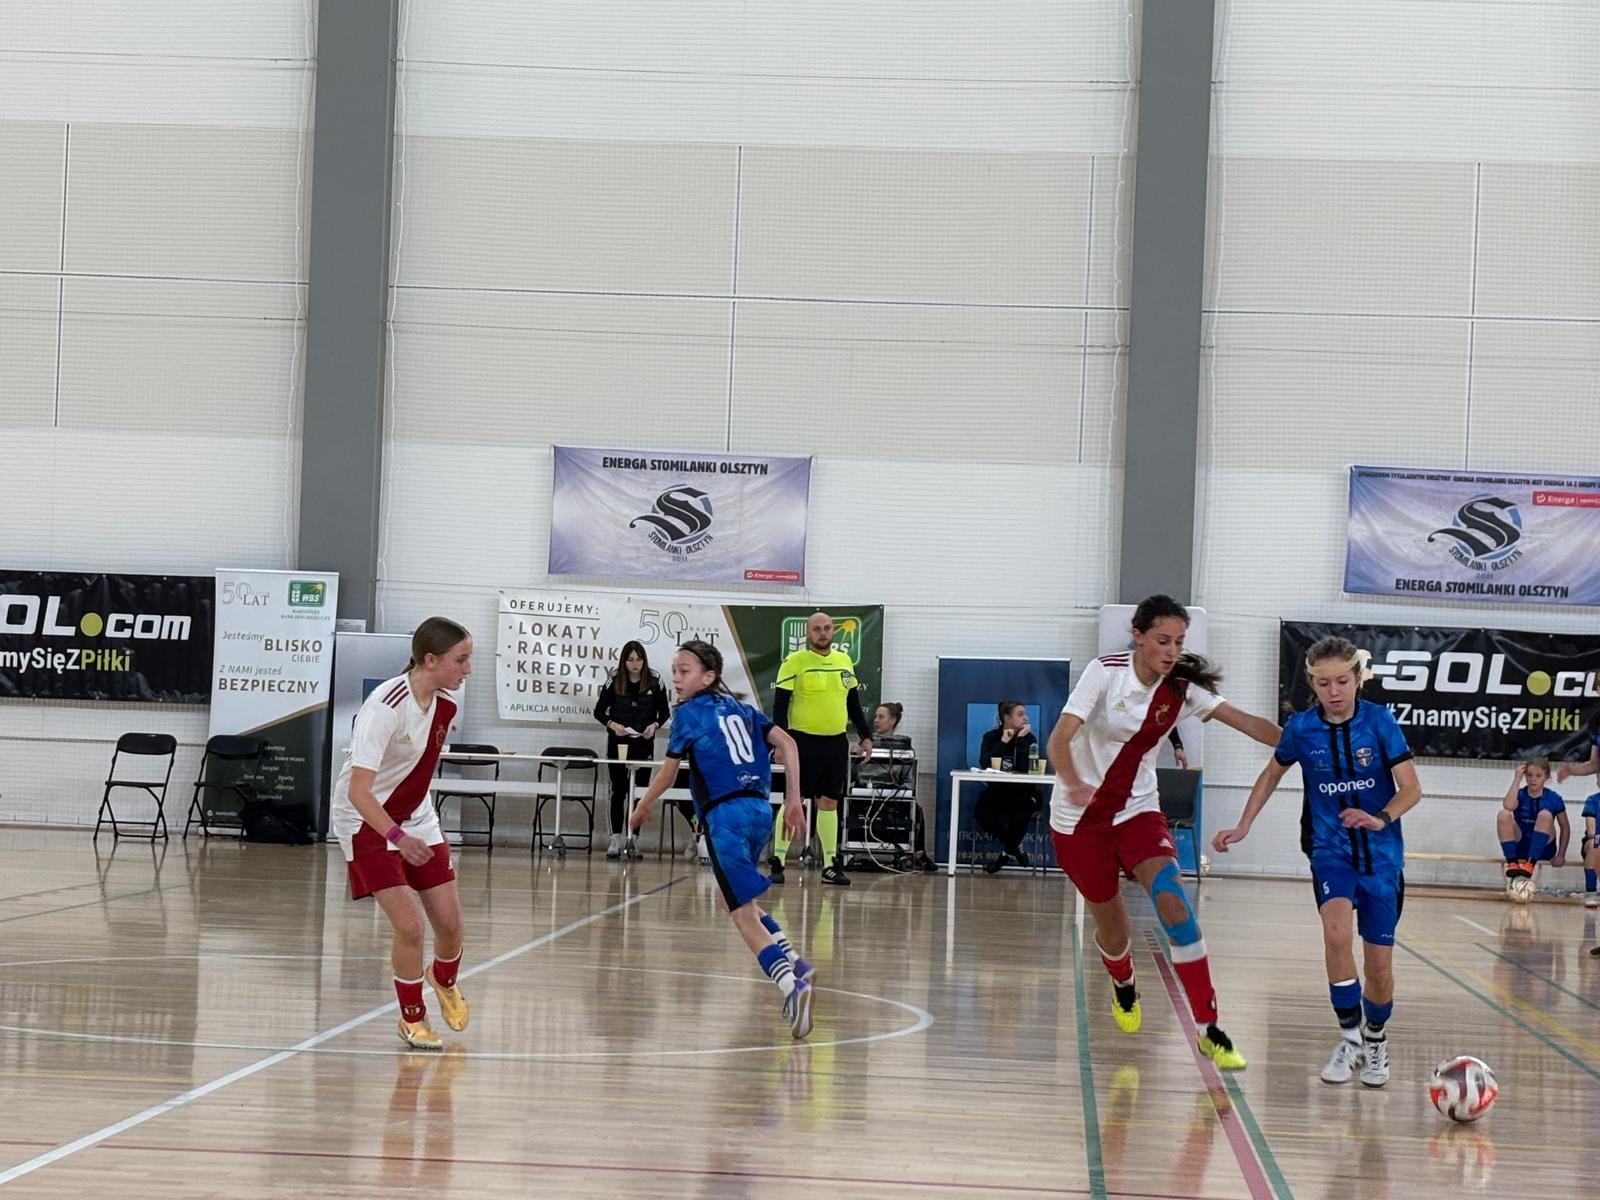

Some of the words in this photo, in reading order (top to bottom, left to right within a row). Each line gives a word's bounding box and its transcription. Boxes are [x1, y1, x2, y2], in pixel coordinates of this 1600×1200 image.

[602, 456, 647, 470] ENERGA
[650, 459, 717, 474] STOMILANKI
[720, 463, 769, 475] OLSZTYN
[1548, 496, 1575, 505] Energa
[648, 531, 682, 555] STOMILANKI
[685, 533, 714, 555] OLSZTYN
[1448, 546, 1487, 571] STOMILANKI
[1491, 549, 1523, 571] OLSZTYN
[222, 581, 250, 604] 50
[1395, 578, 1442, 592] ENERGA
[1445, 581, 1515, 596] STOMILANKI
[1518, 584, 1569, 598] OLSZTYN
[242, 594, 270, 606] LAT
[509, 599, 599, 615] OFERUJEMY:
[518, 621, 601, 640] LOKATY
[638, 609, 688, 645] 50
[222, 631, 265, 643] Jesteśmy
[264, 638, 323, 653] BLISKO
[291, 654, 320, 663] CIEBIE
[517, 641, 620, 661] RACHUNK
[219, 664, 226, 673] Z
[228, 665, 253, 674] NAMI
[254, 664, 282, 676] jesteś
[516, 660, 615, 680] KREDYTY
[218, 678, 319, 693] BEZPIECZNY
[551, 705, 591, 715] MOBILNA
[718, 714, 755, 766] 10
[1319, 776, 1376, 797] oponeo
